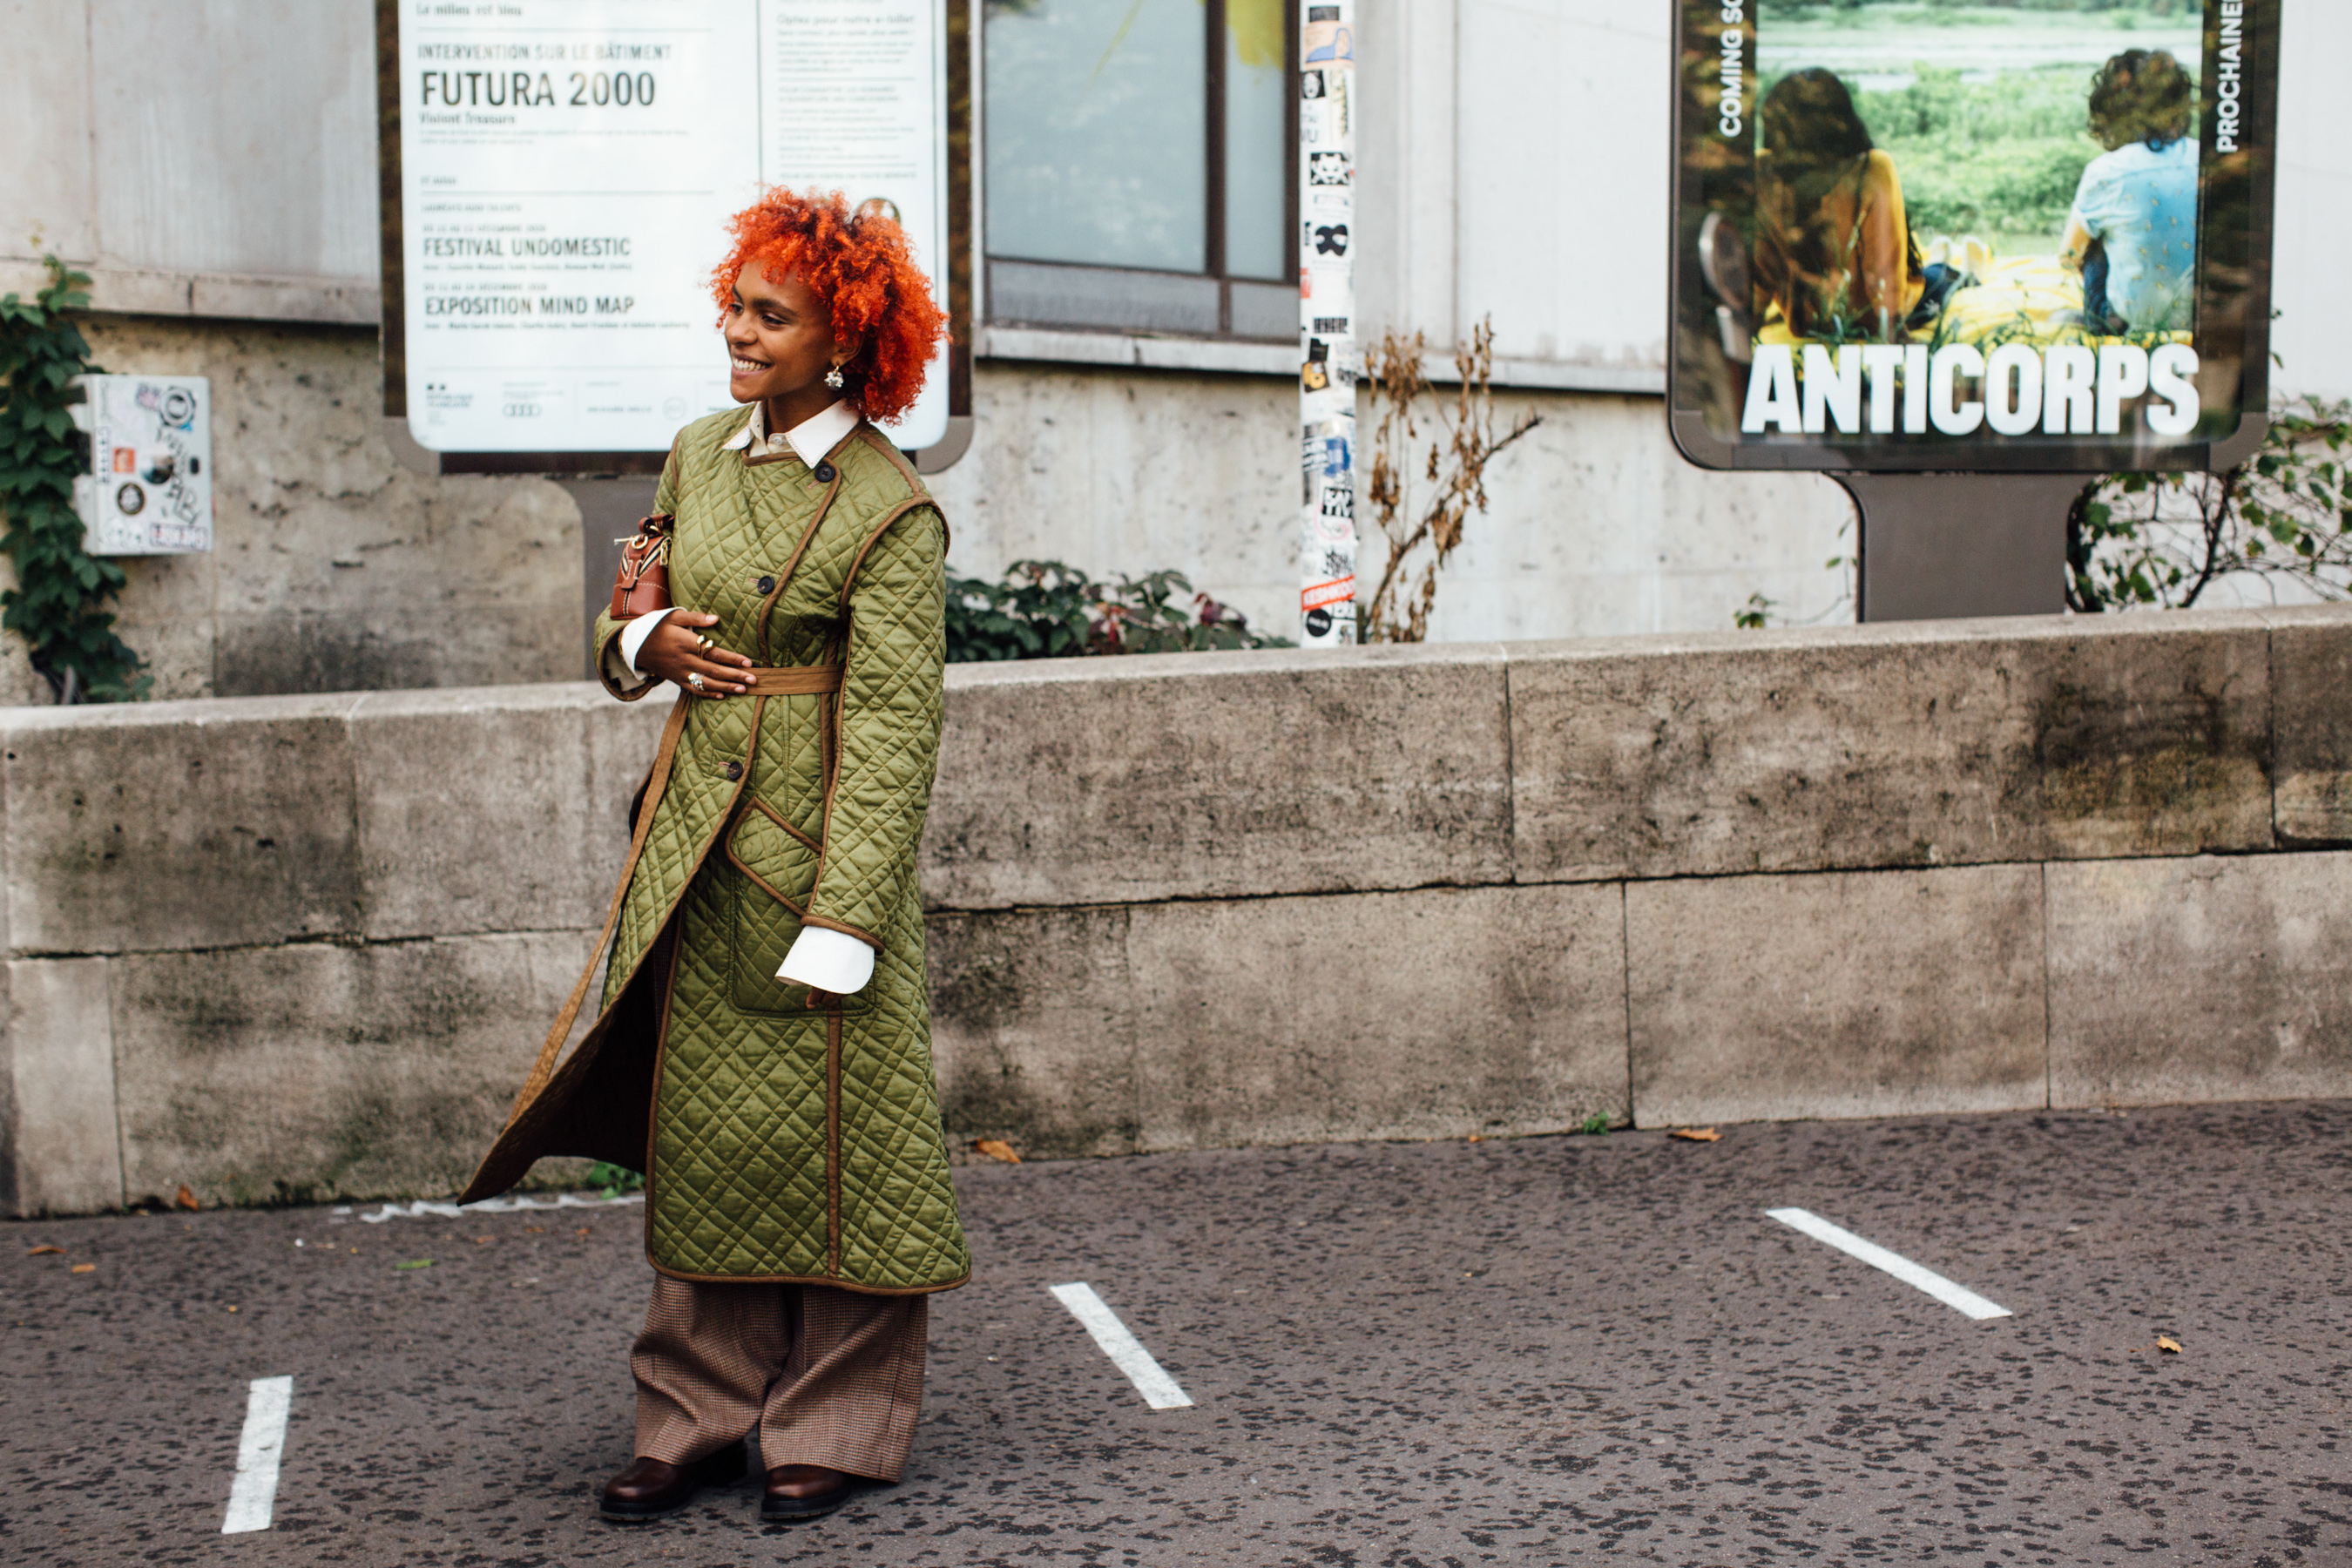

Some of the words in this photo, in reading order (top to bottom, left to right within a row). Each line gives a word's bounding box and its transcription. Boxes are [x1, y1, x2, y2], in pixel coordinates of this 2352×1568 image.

[418, 44, 529, 59] INTERVENTION
[535, 44, 565, 59] SUR
[572, 44, 590, 59] LE
[596, 41, 671, 59] BÂTIMENT
[422, 71, 555, 106] FUTURA
[570, 71, 655, 106] 2000
[1720, 29, 1743, 138] COMING
[2216, 0, 2243, 153] PROCHAINE
[424, 238, 504, 256] FESTIVAL
[511, 238, 631, 256] UNDOMESTIC
[425, 296, 531, 314] EXPOSITION
[540, 296, 587, 314] MIND
[595, 296, 634, 314] MAP
[1742, 343, 2200, 436] ANTICORPS
